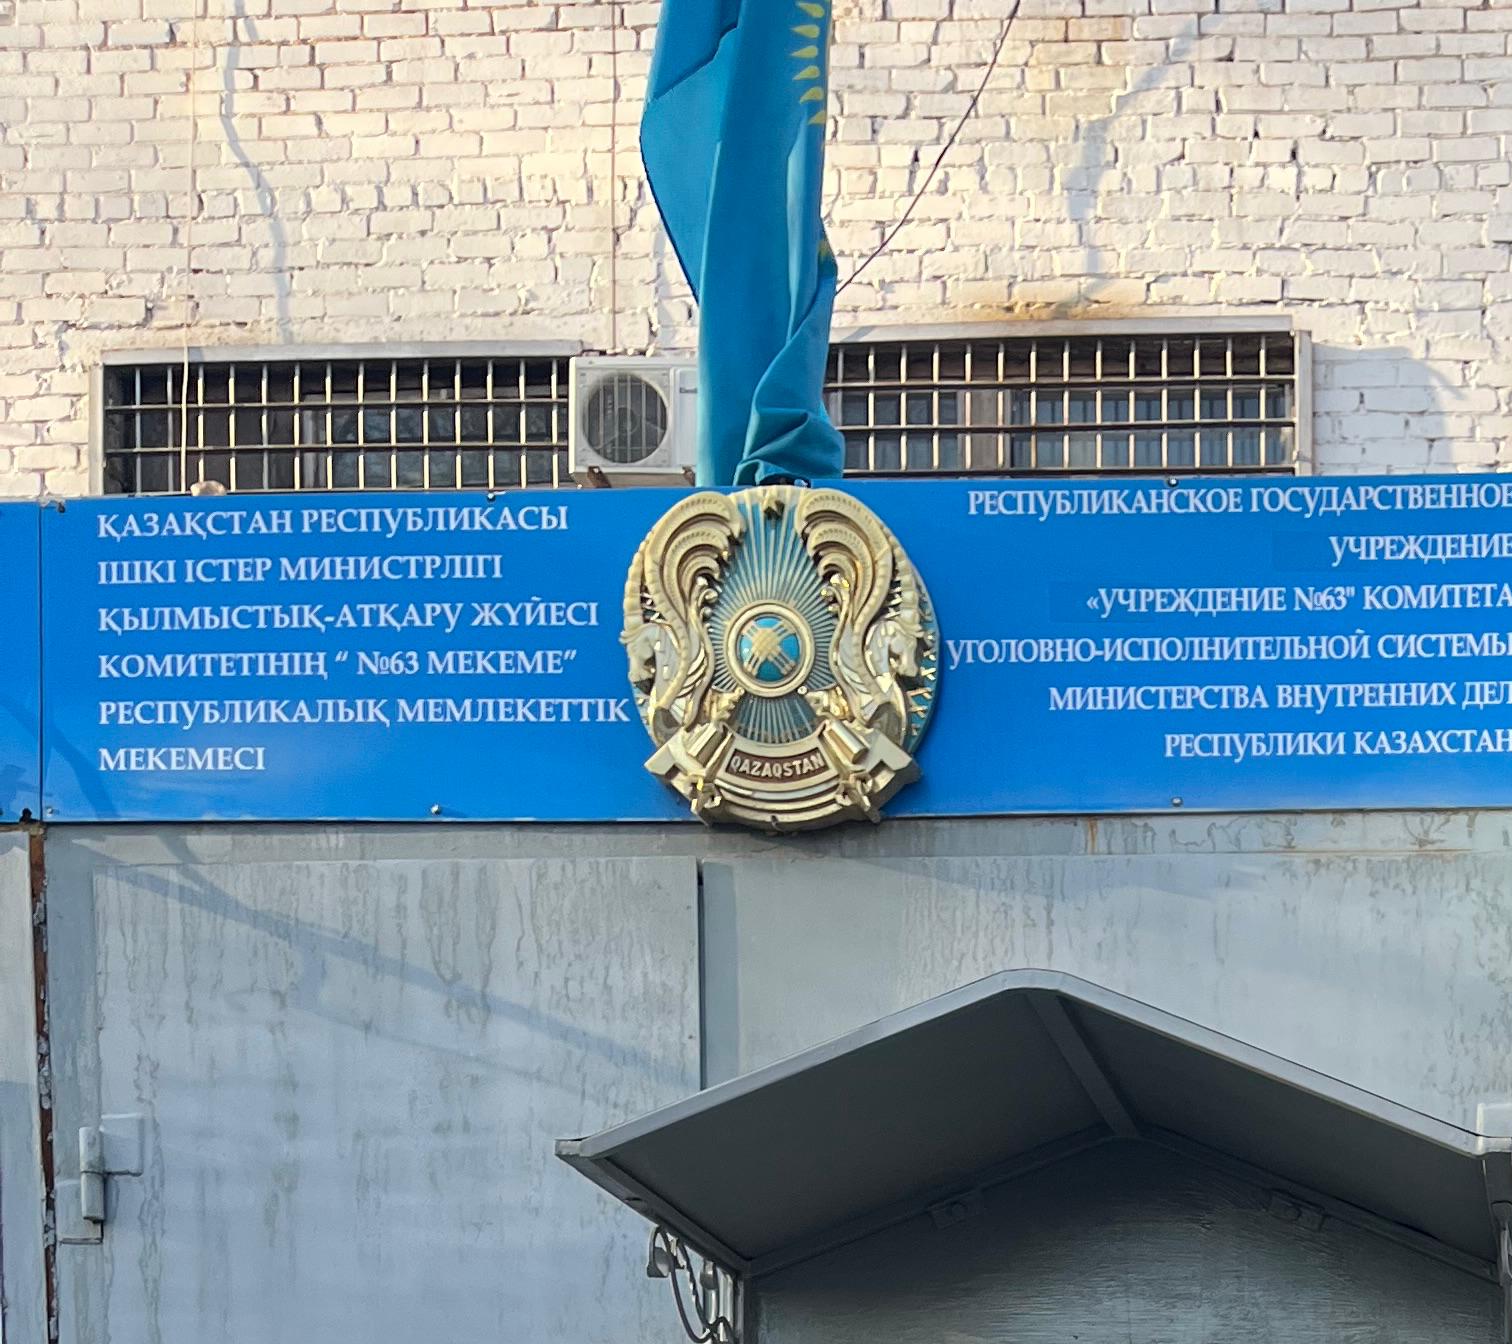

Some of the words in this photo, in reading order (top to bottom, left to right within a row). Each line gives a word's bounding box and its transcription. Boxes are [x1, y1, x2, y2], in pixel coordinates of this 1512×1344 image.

[968, 487, 1243, 522] РЕСПУБЛИКАНСКОЕ
[98, 511, 293, 541] ҚАЗАҚСТАН
[302, 506, 568, 537] РЕСПУБЛИКАСЫ
[98, 560, 176, 585] ІШКІ
[185, 558, 272, 582] ІСТЕР
[279, 554, 502, 580] МИНИСТРЛІГІ
[98, 602, 461, 635] ҚЫЛМЫСТЫҚ-АТҚАРУ
[471, 596, 598, 627] ЖҮЙЕСІ
[1087, 587, 1287, 618] «УЧРЕЖДЕНИЕ
[98, 652, 328, 680] КОМИТЕТІНІҢ
[357, 650, 419, 675] №63
[947, 628, 1371, 670] УГОЛОВНО-ИСПОЛНИТЕЛЬНОЙ
[99, 699, 391, 730] РЕСПУБЛИКАЛЫҚ
[397, 698, 630, 723] МЕМЛЕКЕТТІК
[1049, 685, 1269, 711] МИНИСТЕРСТВА
[1276, 682, 1457, 714] ВНУТРЕННИХ
[98, 746, 266, 771] МЕКЕМЕСІ
[1165, 731, 1346, 763] РЕСПУБЛИКИ
[731, 752, 825, 778] QAZAQSTAN
